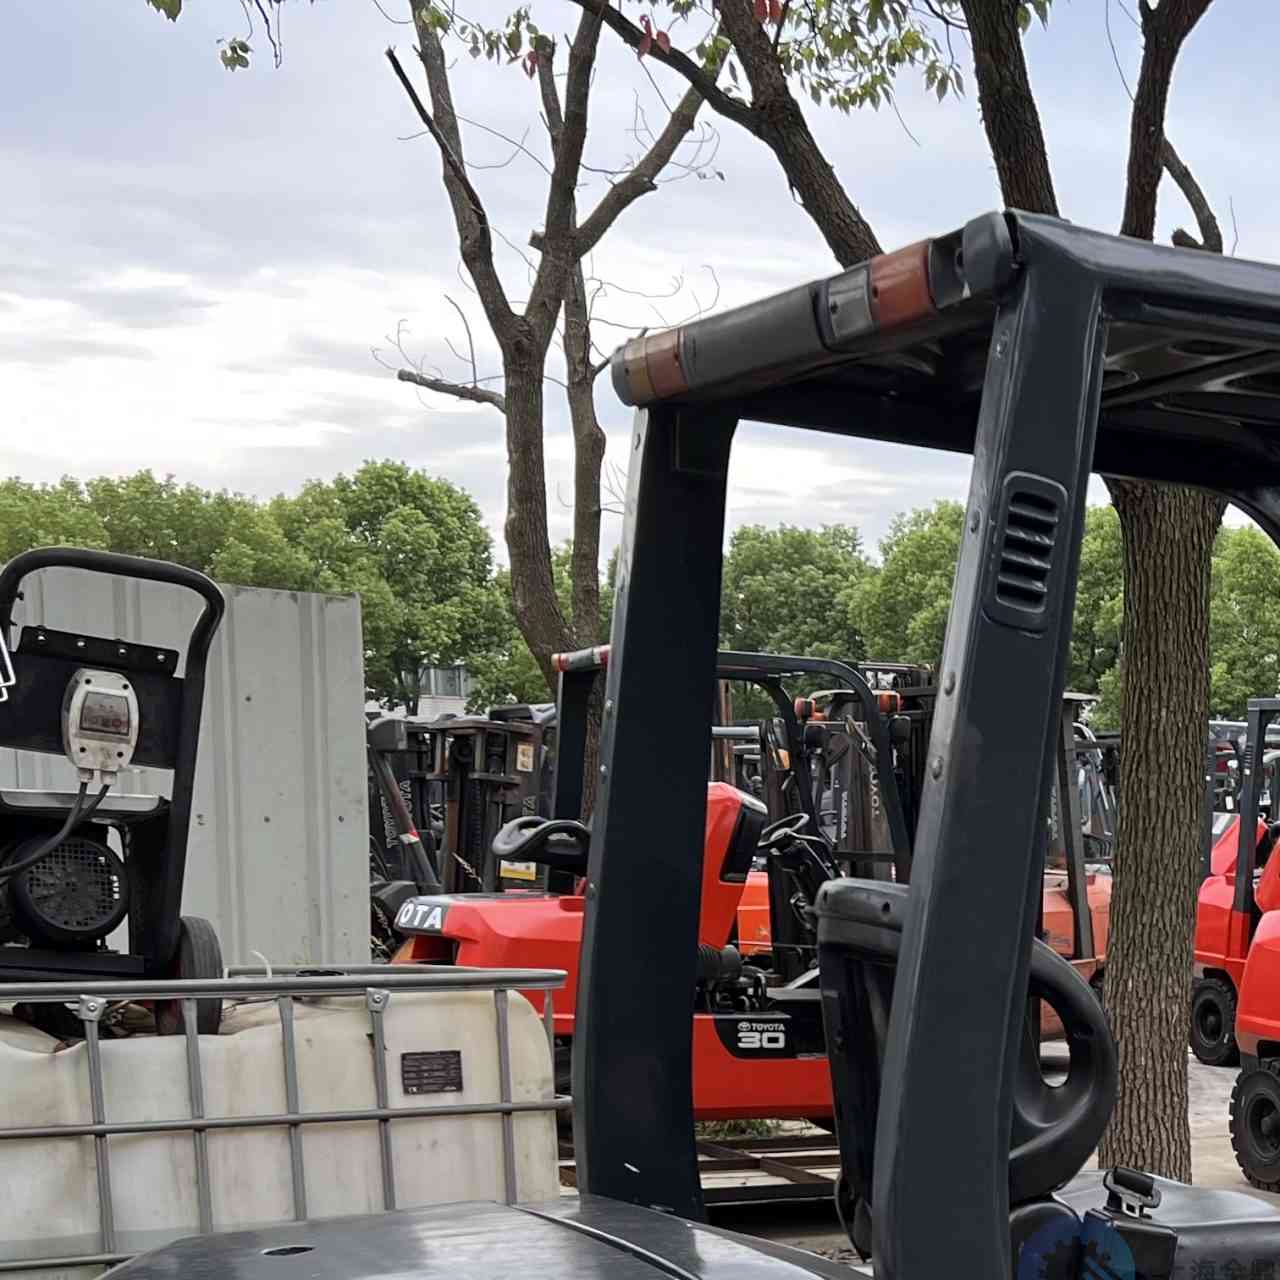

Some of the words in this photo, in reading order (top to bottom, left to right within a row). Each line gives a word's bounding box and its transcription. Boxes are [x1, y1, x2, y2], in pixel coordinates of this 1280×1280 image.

[399, 901, 443, 929] OTA
[751, 1022, 785, 1031] TOYOTA
[737, 1031, 785, 1048] 30
